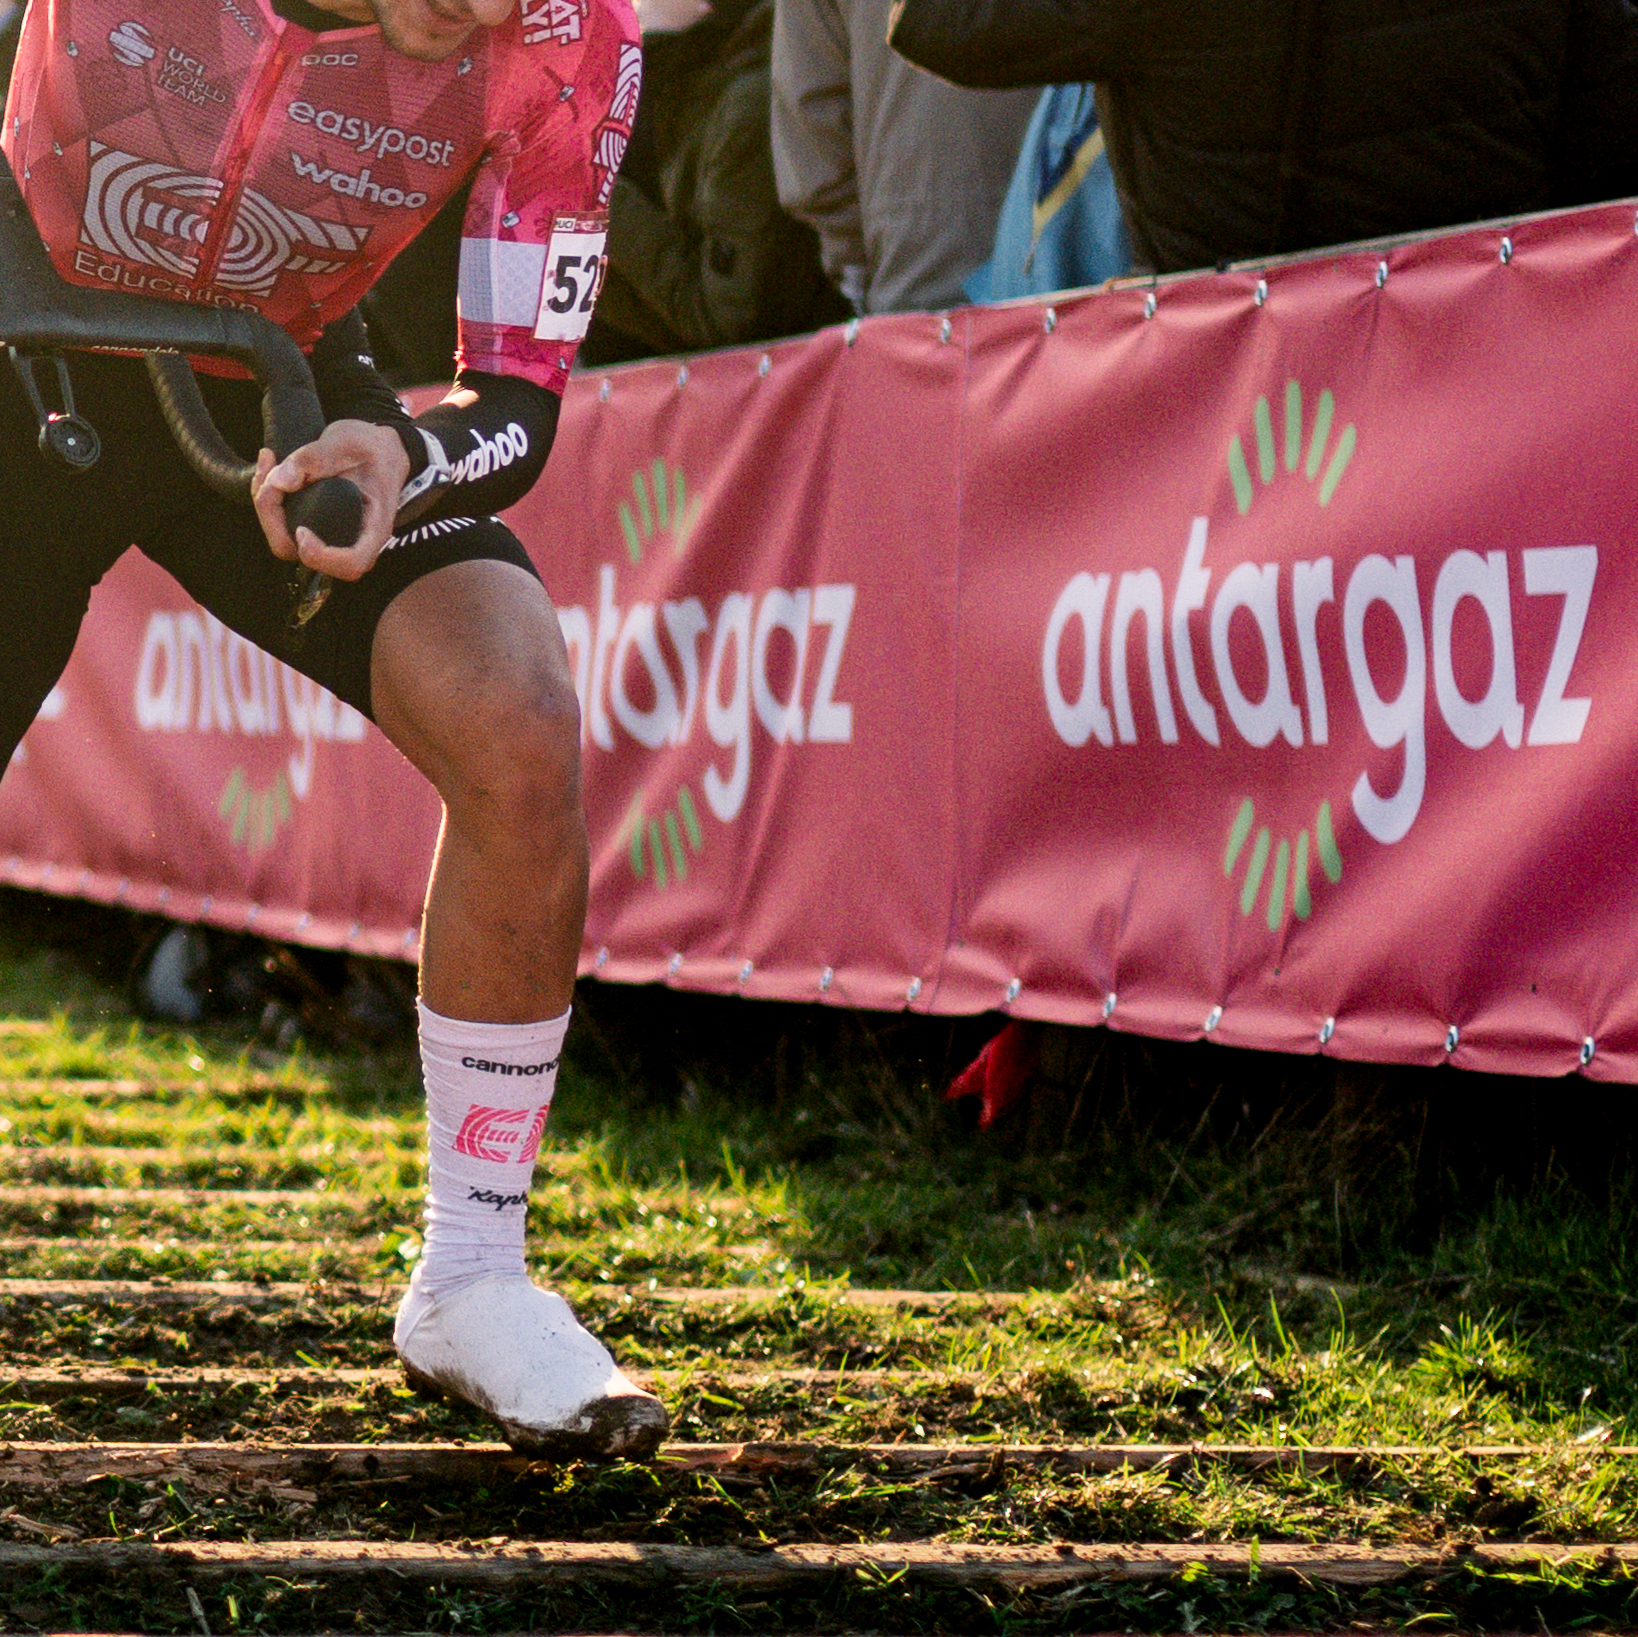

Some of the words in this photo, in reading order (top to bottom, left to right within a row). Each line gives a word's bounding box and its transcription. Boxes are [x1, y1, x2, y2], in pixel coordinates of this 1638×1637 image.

[301, 52, 359, 67] poc
[287, 99, 455, 168] easypost
[289, 150, 428, 210] wahoo
[451, 421, 529, 486] wahoo
[1043, 515, 1599, 844] antargaz
